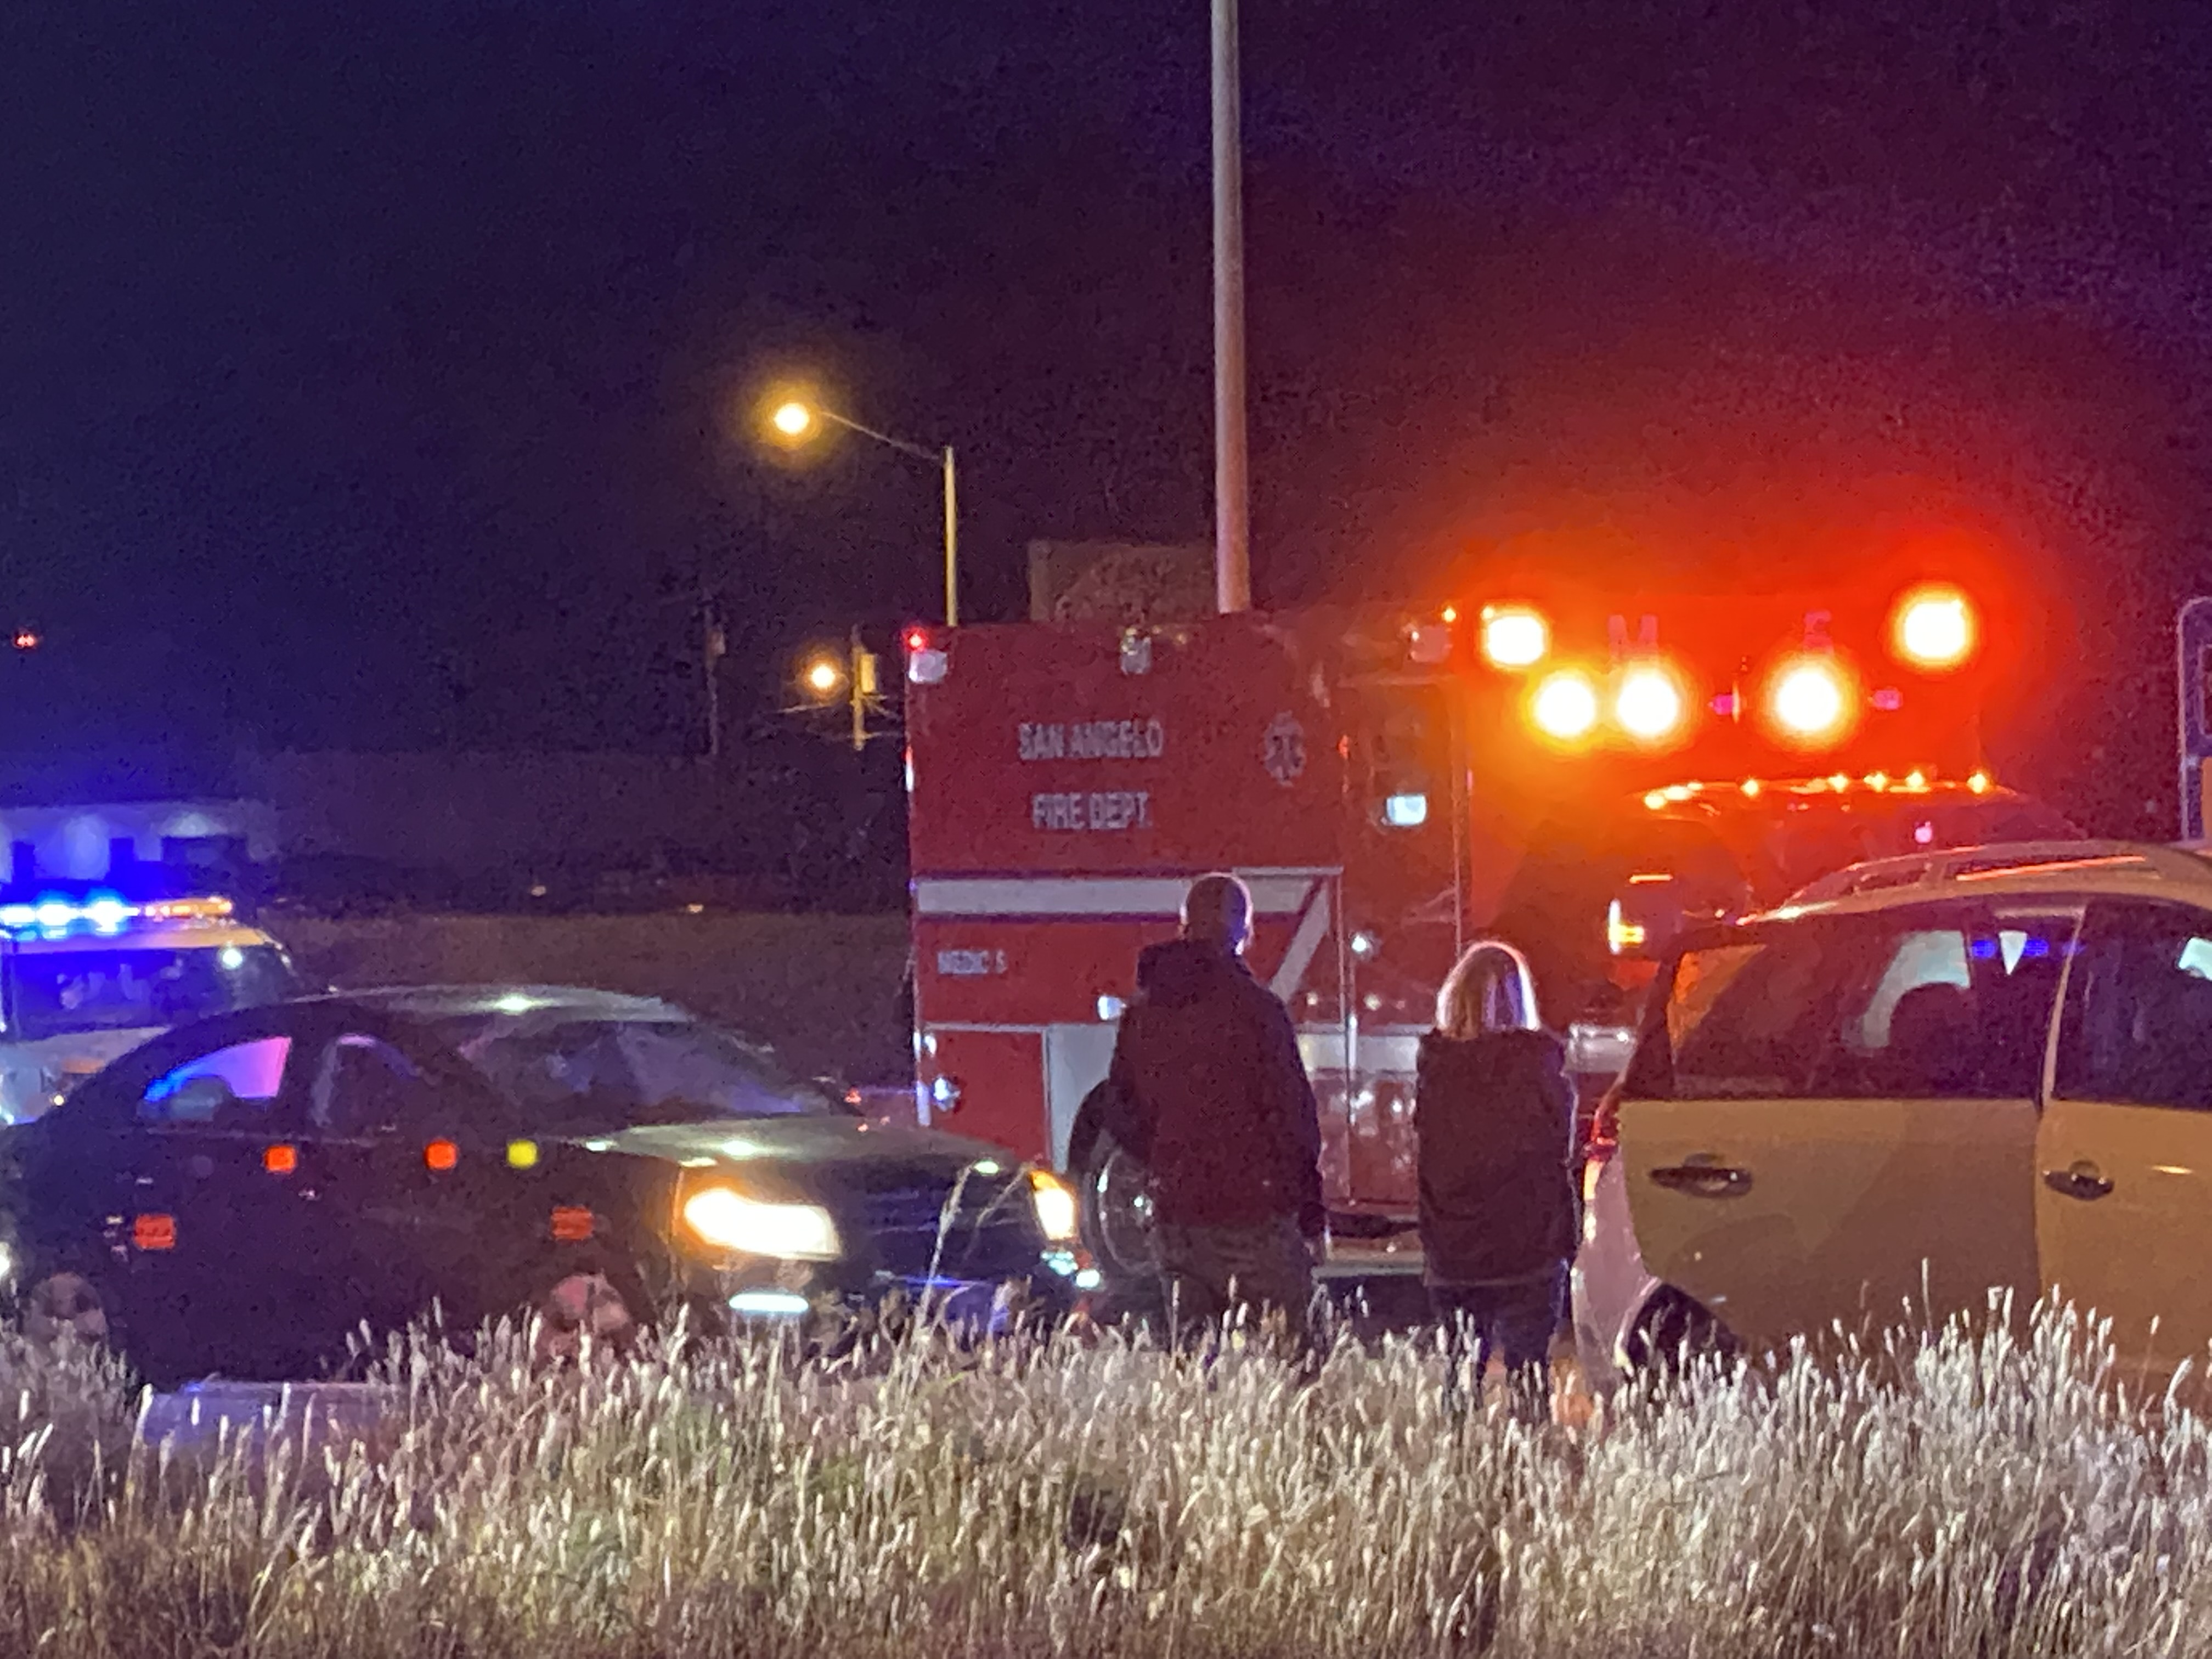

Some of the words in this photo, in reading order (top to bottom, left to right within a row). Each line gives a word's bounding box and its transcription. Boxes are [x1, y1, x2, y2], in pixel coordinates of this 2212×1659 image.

[1019, 723, 1064, 760] SAN
[1070, 719, 1164, 759] ANGELO
[1032, 792, 1085, 830] FIRE
